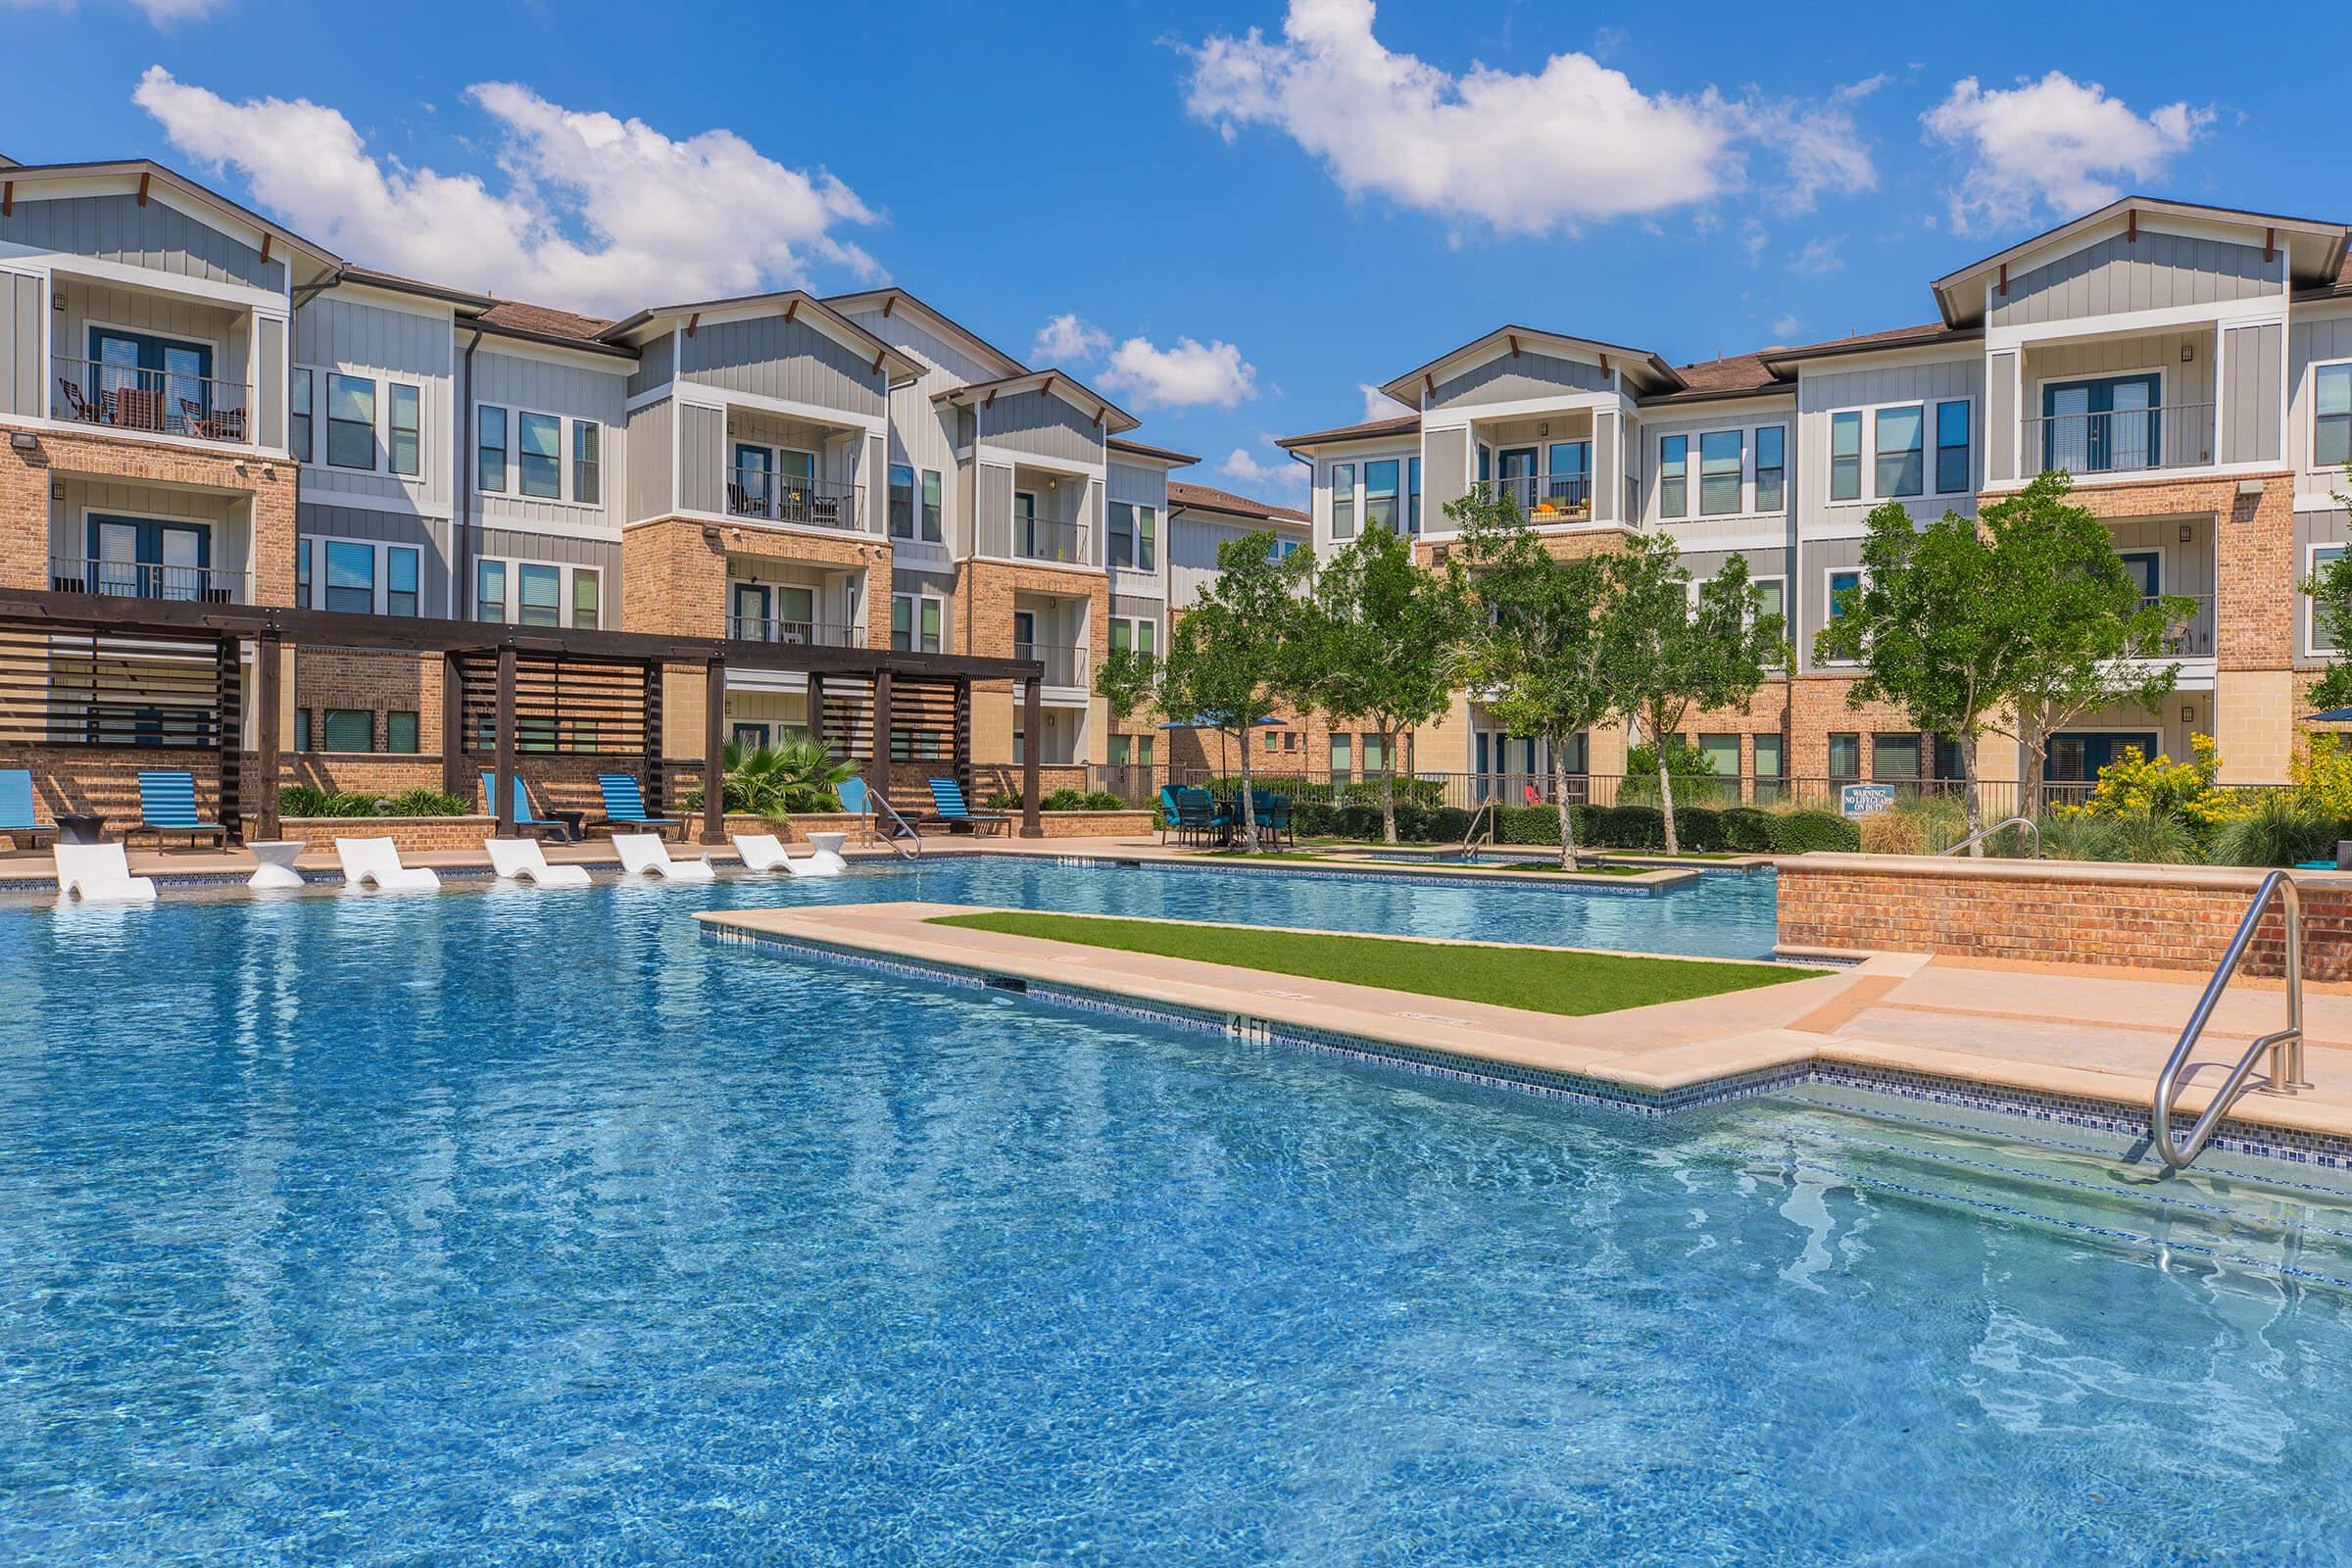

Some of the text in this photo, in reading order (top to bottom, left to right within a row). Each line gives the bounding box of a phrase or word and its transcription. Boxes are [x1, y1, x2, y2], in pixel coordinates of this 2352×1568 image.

[718, 924, 754, 942] 4 FT 6 IN
[1232, 1014, 1267, 1040] 4 FT
